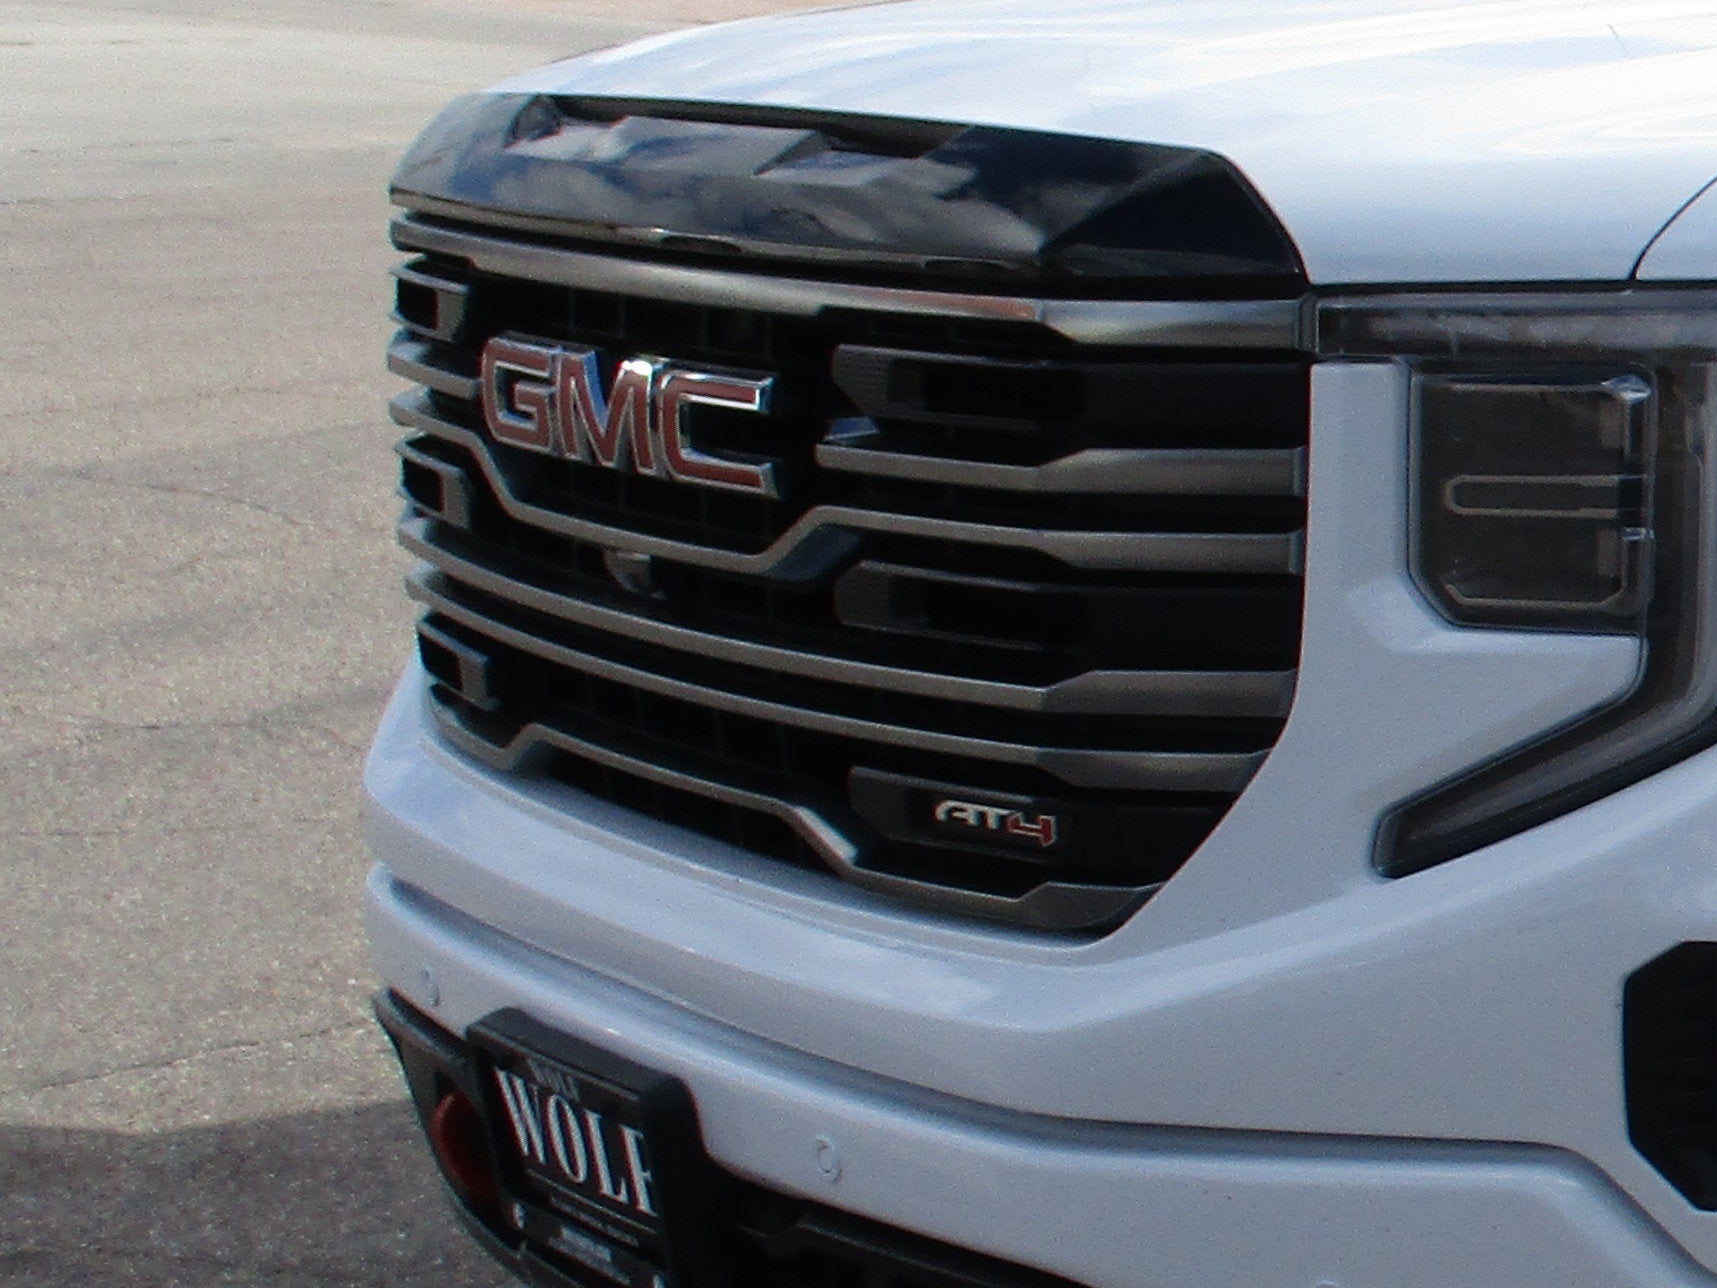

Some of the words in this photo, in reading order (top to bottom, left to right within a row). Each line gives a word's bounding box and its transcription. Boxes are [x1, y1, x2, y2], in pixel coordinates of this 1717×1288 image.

[481, 332, 777, 497] GMC
[935, 799, 1056, 847] AT4
[494, 1066, 658, 1218] WOLF
